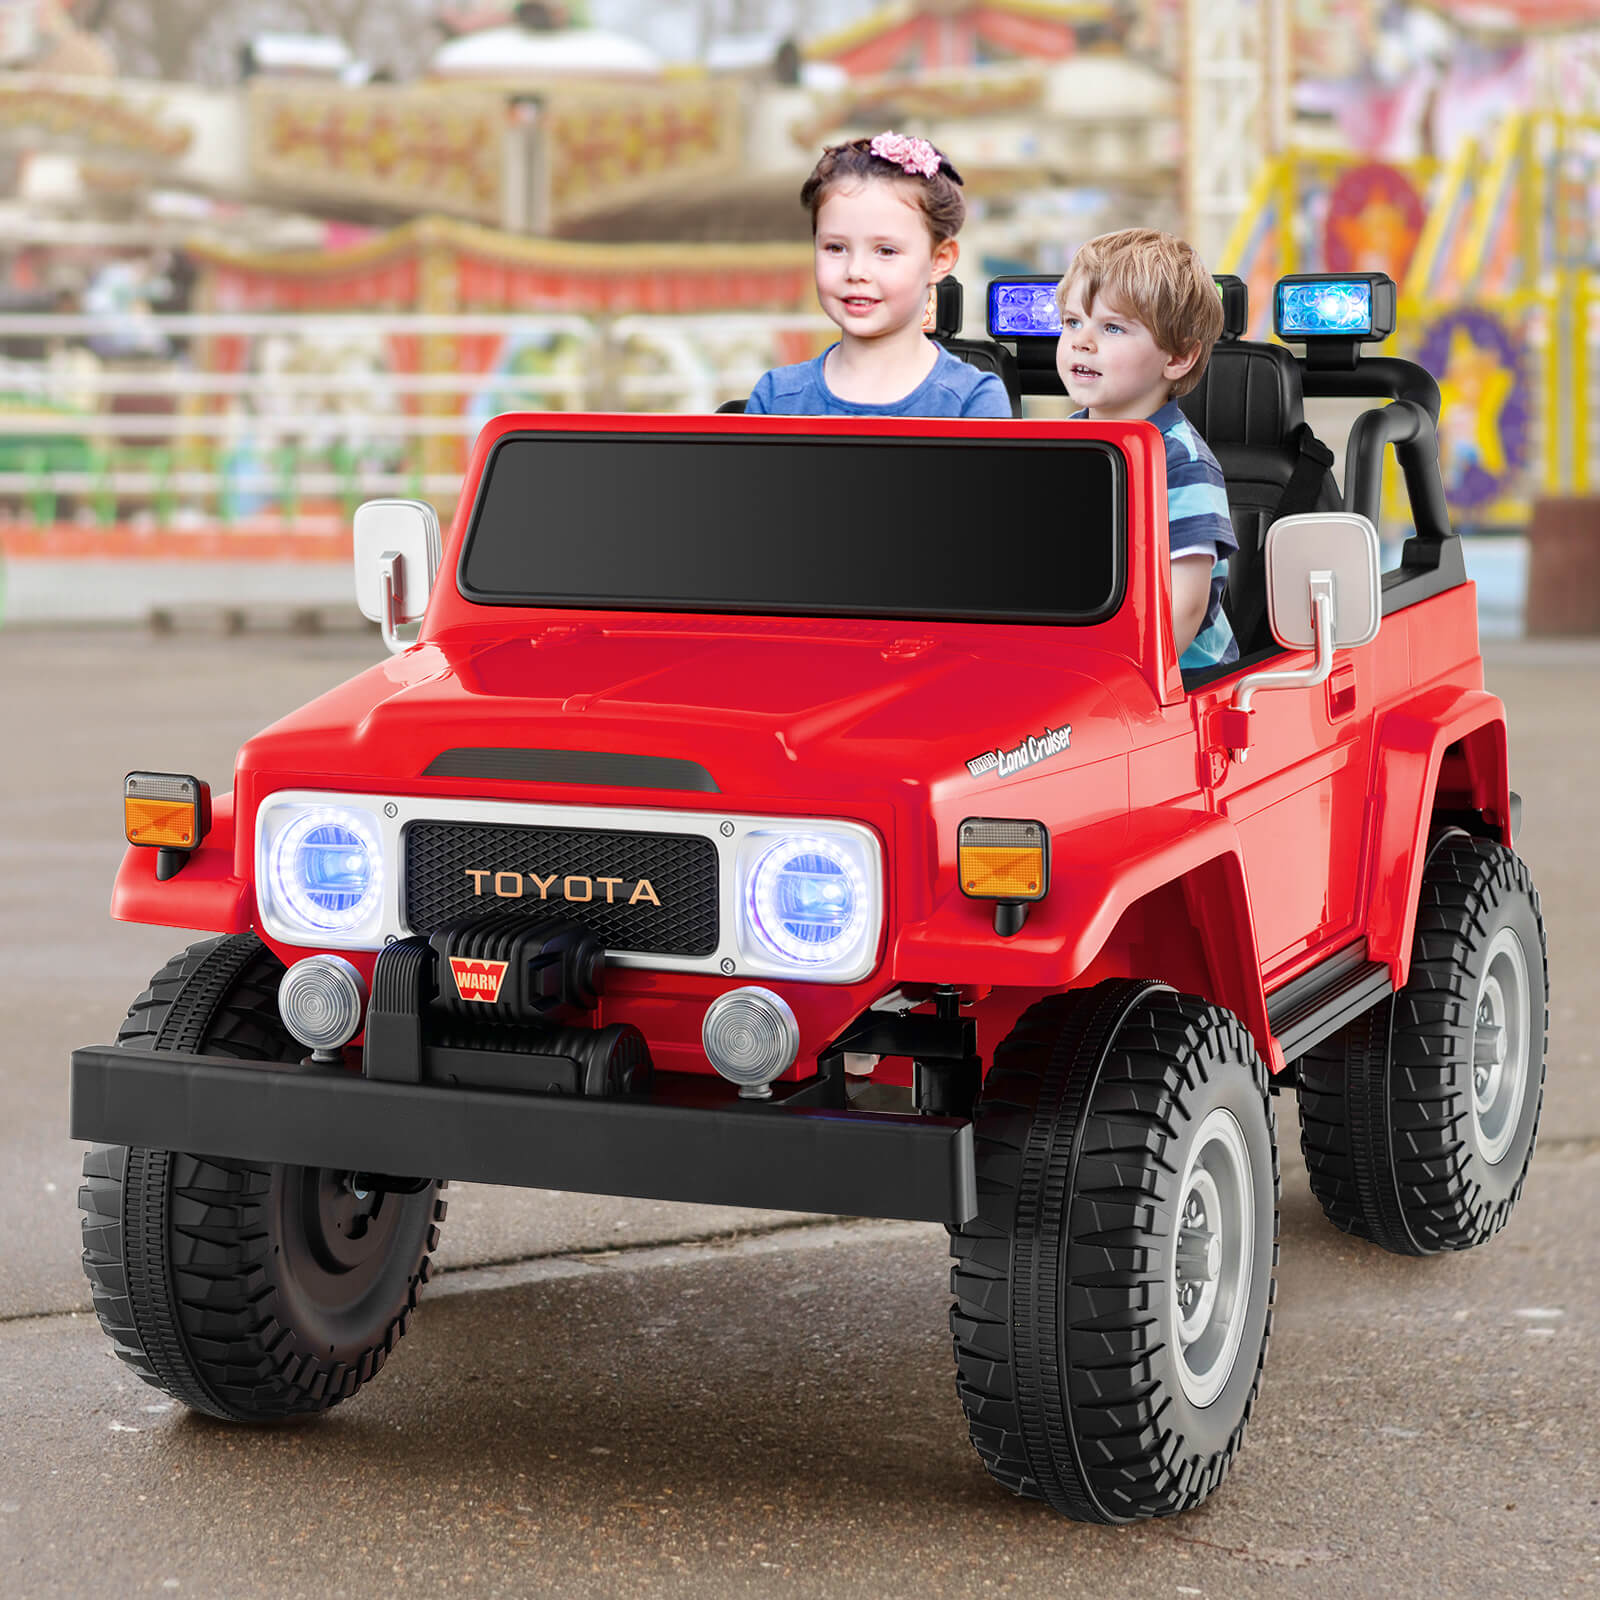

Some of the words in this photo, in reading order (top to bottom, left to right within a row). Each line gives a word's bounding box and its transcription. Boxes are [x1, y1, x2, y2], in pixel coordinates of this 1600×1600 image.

[967, 752, 999, 776] TOYOTA
[998, 741, 1029, 776] Land
[1028, 725, 1072, 762] Cruiser
[464, 869, 662, 906] TOYOTA
[456, 971, 498, 991] WARN
